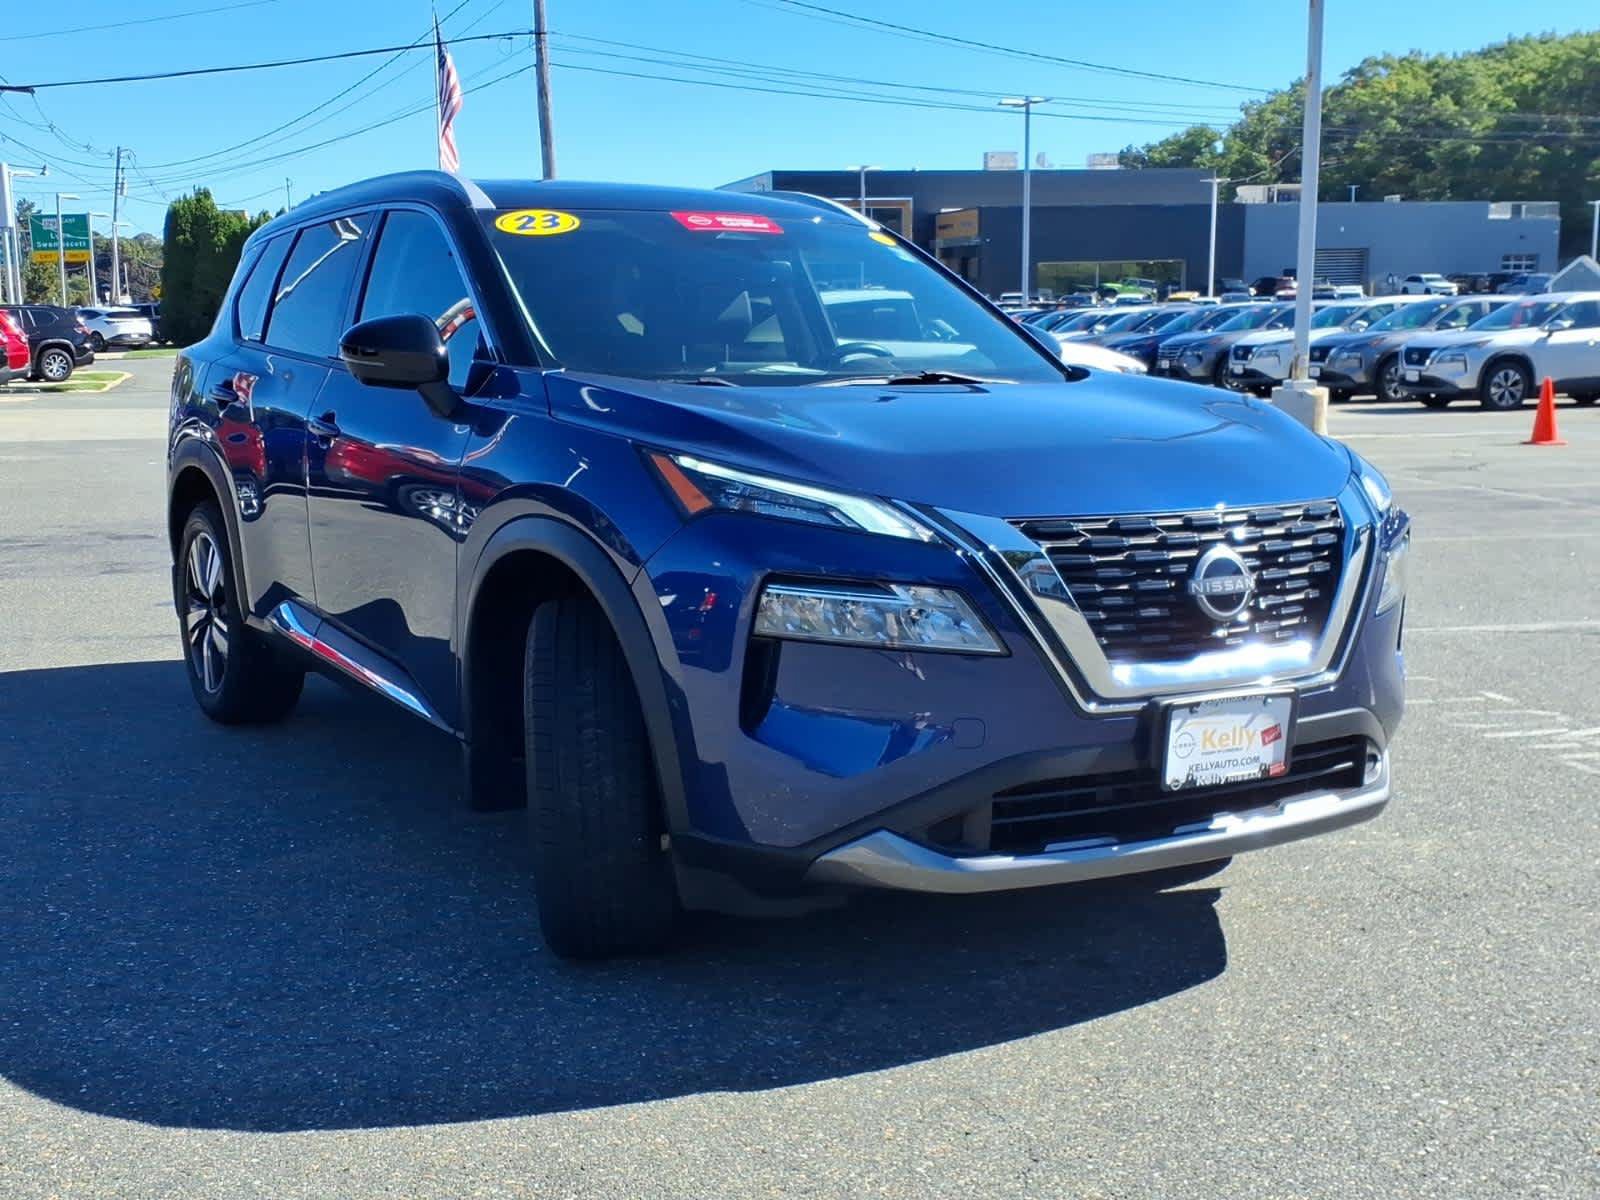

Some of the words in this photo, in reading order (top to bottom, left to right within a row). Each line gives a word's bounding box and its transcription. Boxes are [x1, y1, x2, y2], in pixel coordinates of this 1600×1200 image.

[513, 213, 561, 231] 23
[1191, 577, 1256, 593] NISSAN
[1201, 725, 1255, 752] Kelly
[1188, 756, 1261, 773] KELLYAUTO.COM
